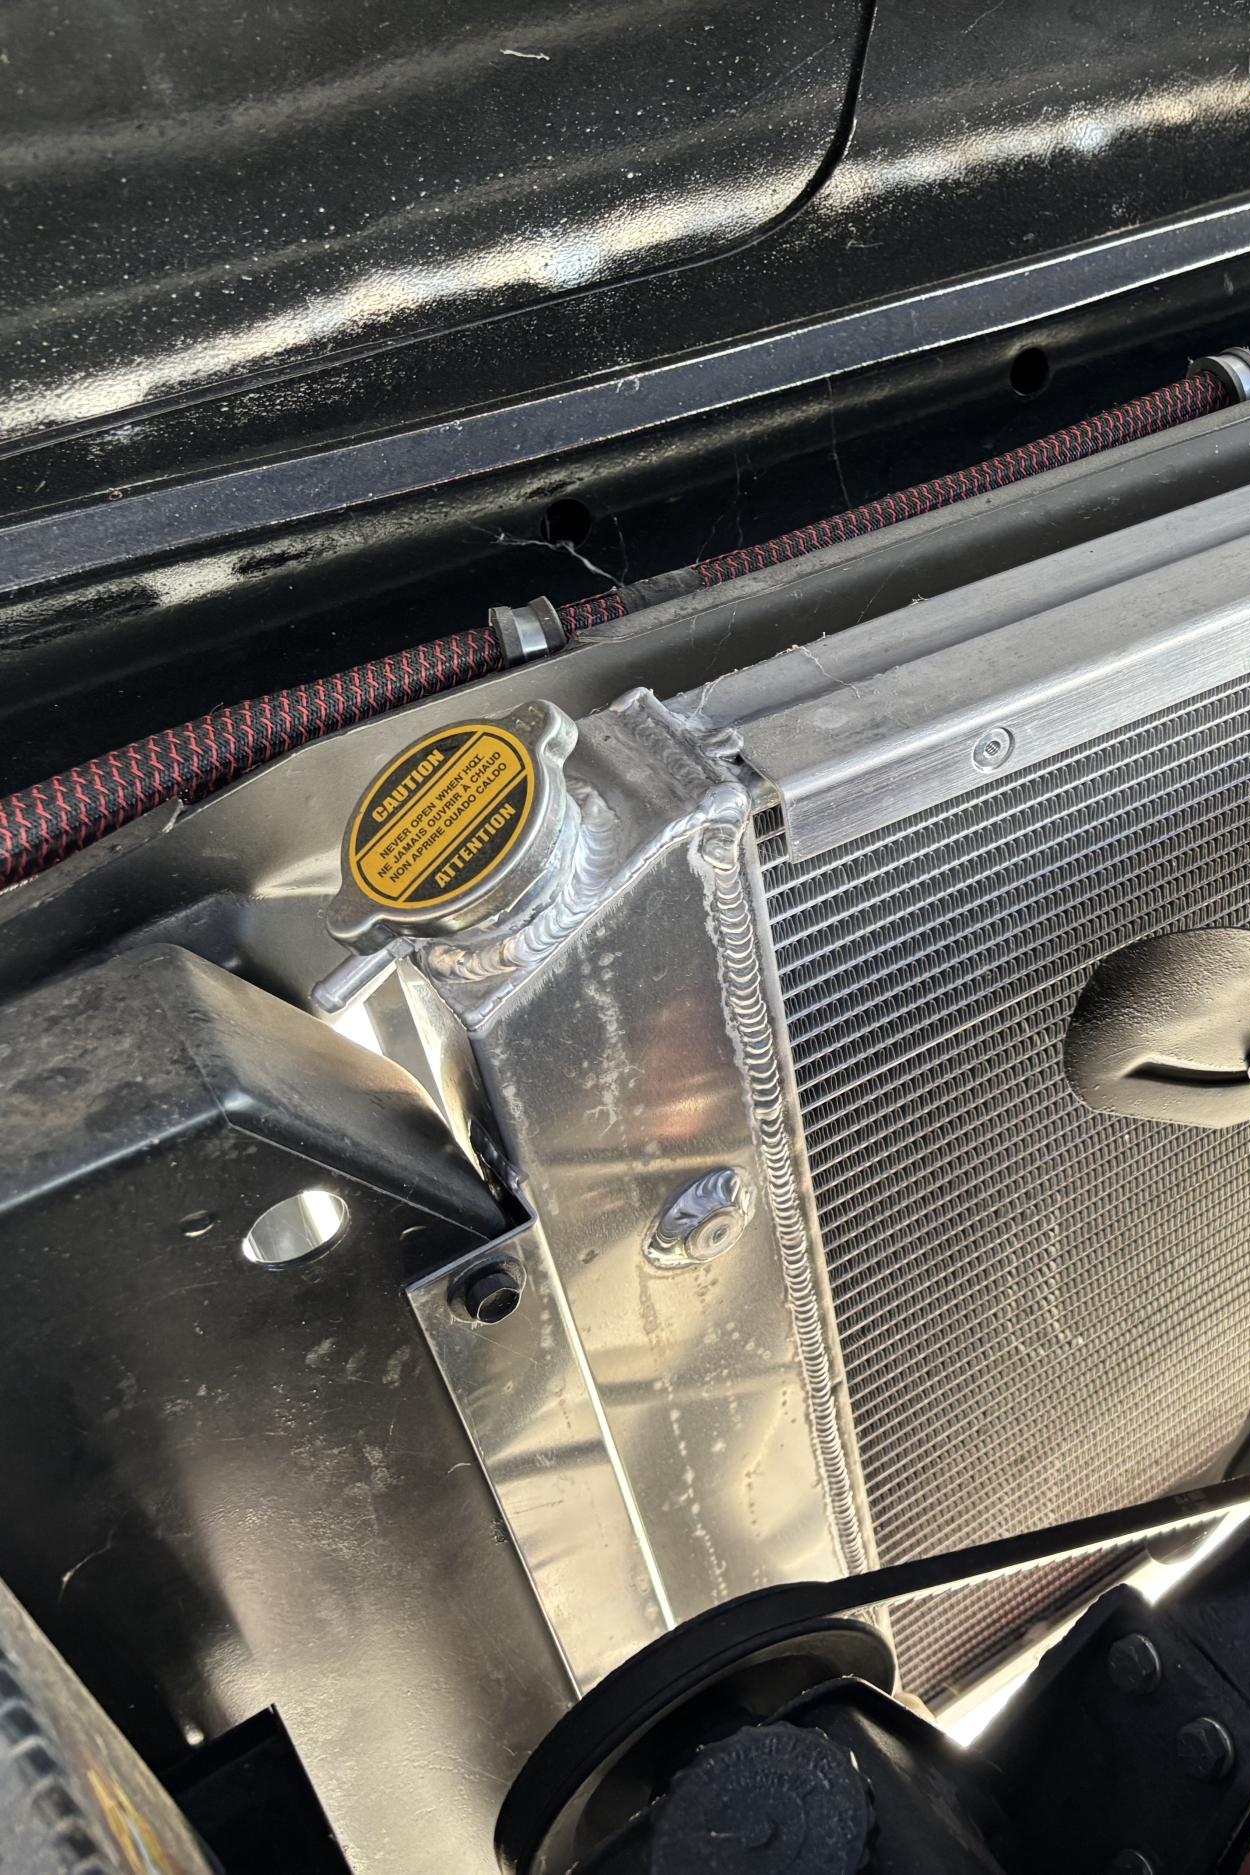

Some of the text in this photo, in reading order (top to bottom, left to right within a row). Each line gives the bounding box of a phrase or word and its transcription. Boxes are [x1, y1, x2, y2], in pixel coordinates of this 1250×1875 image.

[371, 748, 446, 824] CAUTION
[377, 751, 502, 879] NE JAMAIS OUVRIR À CHAUD
[379, 753, 484, 860] NEVER OPEN WHEN HOT
[389, 762, 508, 883] NON APRIRE QUADO CALDO
[433, 801, 517, 889] ATTENTION
